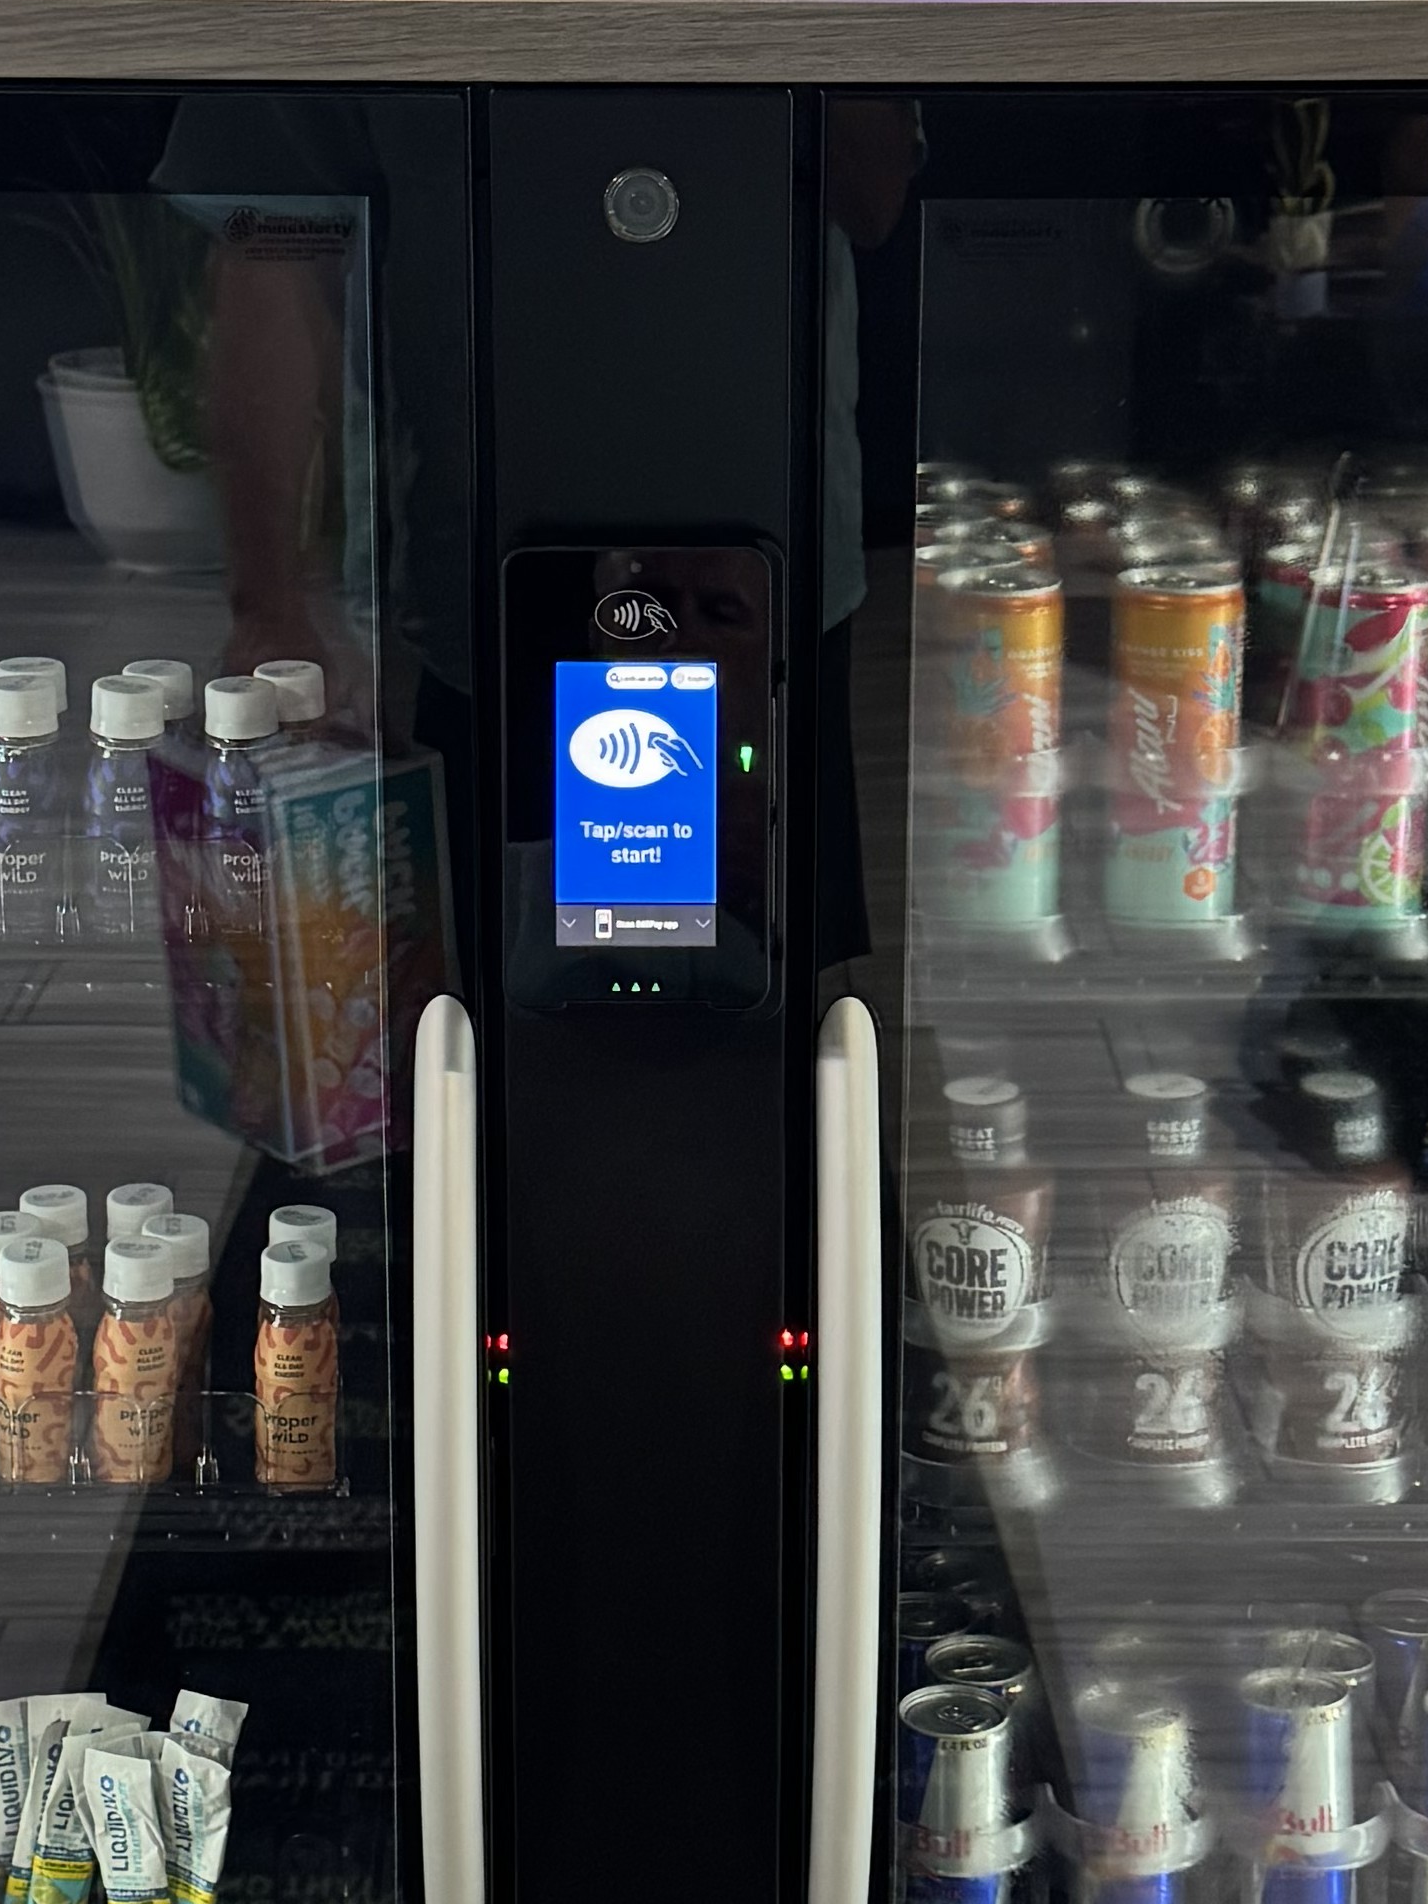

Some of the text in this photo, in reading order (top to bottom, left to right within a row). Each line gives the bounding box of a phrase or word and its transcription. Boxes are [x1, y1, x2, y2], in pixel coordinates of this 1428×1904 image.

[579, 820, 693, 843] Tap/scan to
[611, 846, 662, 864] start!
[926, 1240, 1009, 1288] CORE
[927, 1284, 1007, 1320] POWER
[0, 1769, 21, 1838] LIQUID
[106, 1810, 130, 1873] LIQUID
